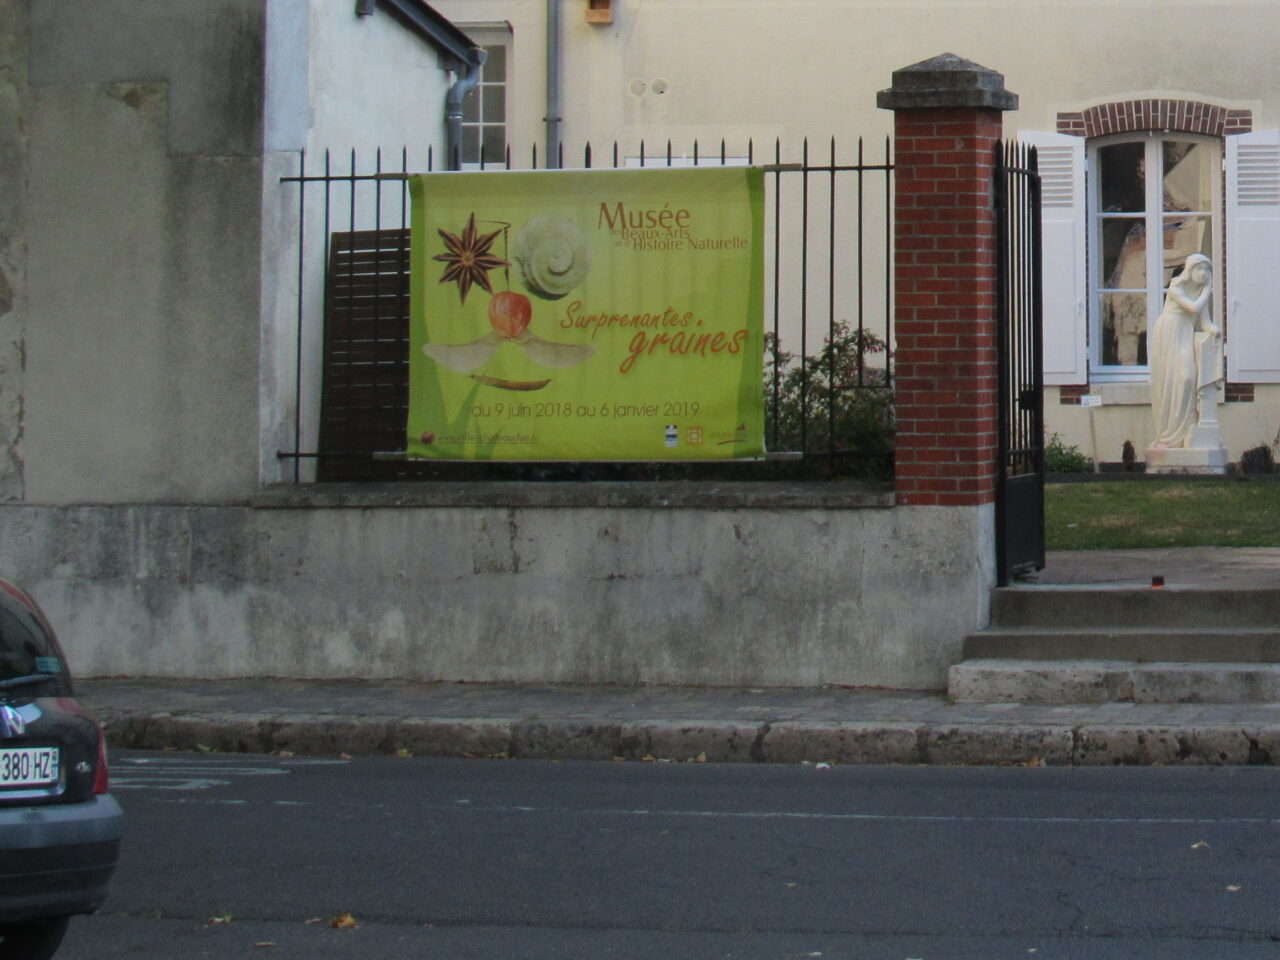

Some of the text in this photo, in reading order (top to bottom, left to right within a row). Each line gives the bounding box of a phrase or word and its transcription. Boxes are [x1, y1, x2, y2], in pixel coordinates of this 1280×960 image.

[598, 201, 691, 229] Musée
[622, 228, 691, 240] Beaux-Arts
[688, 236, 749, 250] Naturelle
[560, 301, 692, 340] Surprenantes
[618, 321, 749, 374] graines
[471, 402, 700, 419] du 9 juin 2018 au 6 janvier 2019
